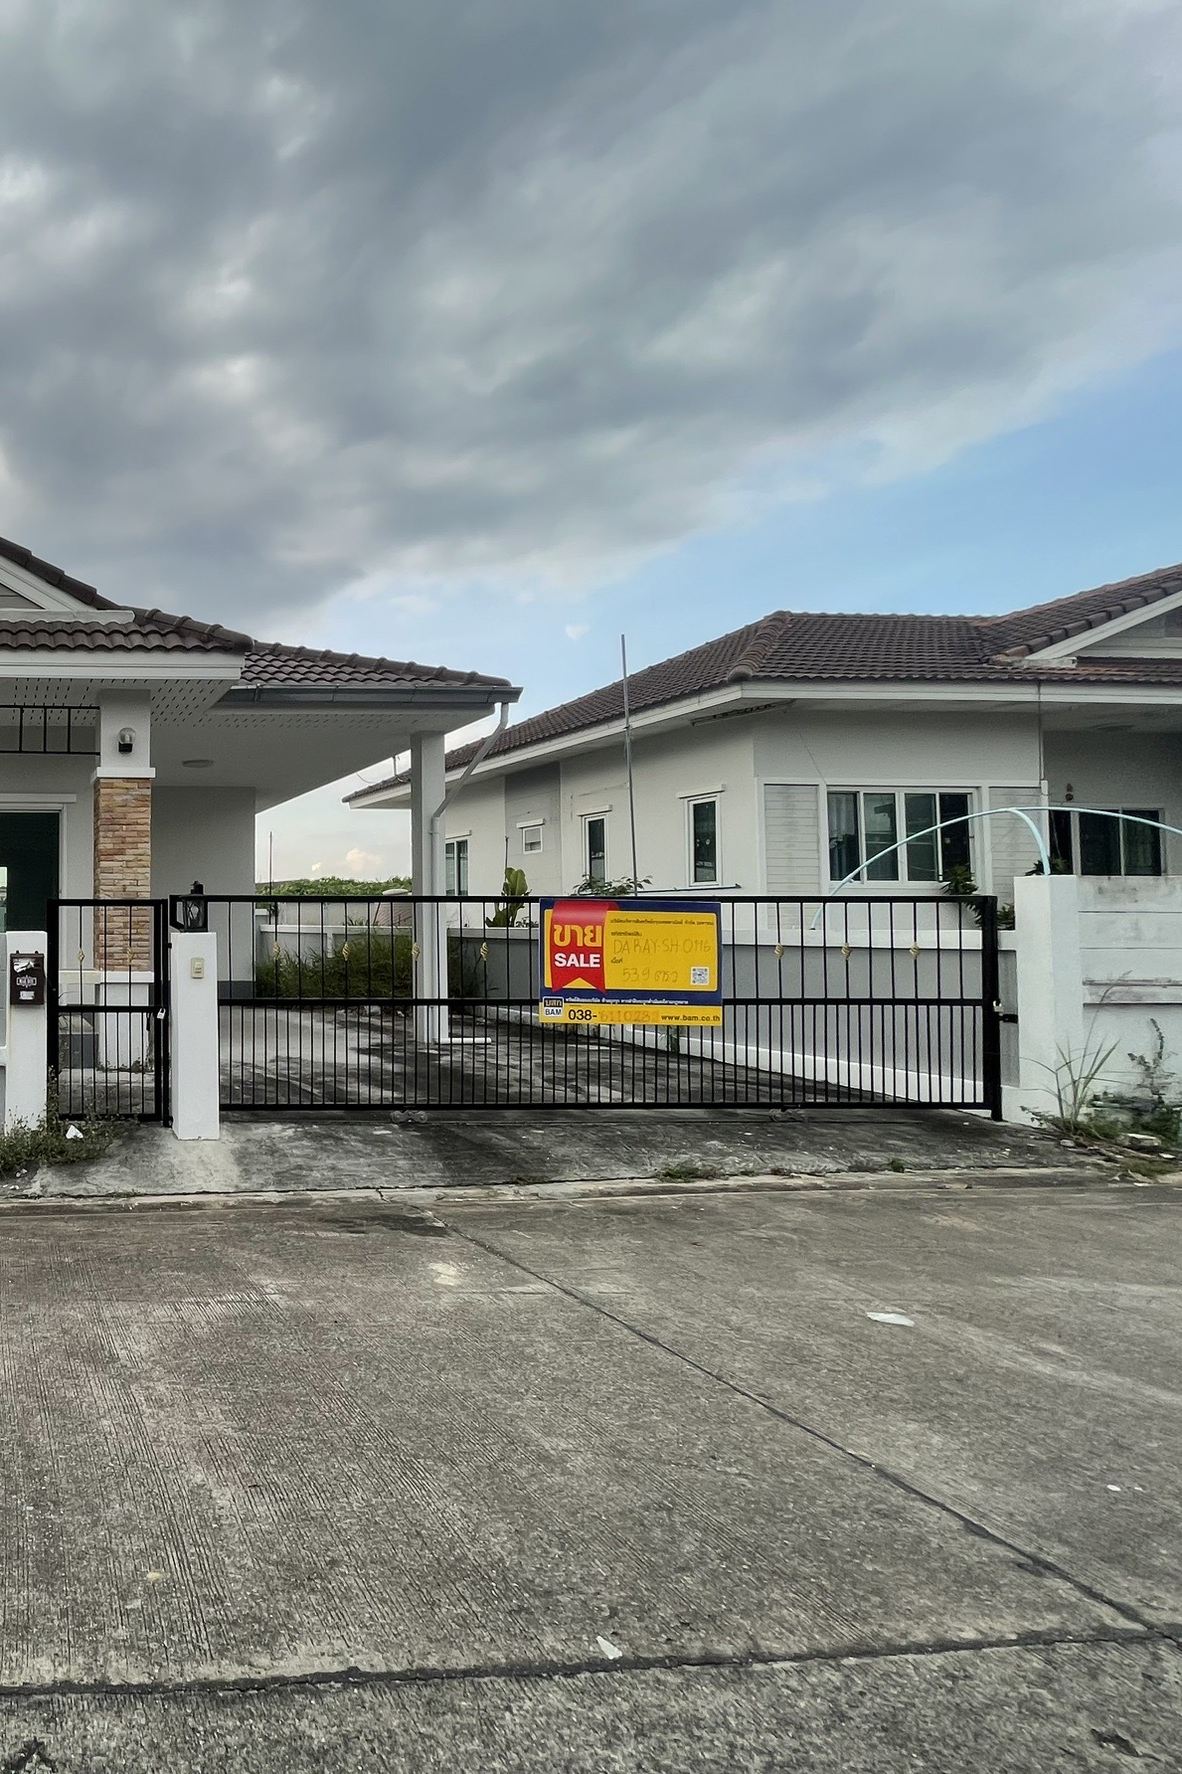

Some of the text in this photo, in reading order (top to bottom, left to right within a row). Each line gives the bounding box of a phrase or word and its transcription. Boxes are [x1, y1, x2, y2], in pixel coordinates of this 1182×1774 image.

[553, 924, 602, 947] ขาย
[554, 953, 601, 968] SALE
[545, 1008, 562, 1016] BAM
[661, 1014, 720, 1022] www.bam.co.th
